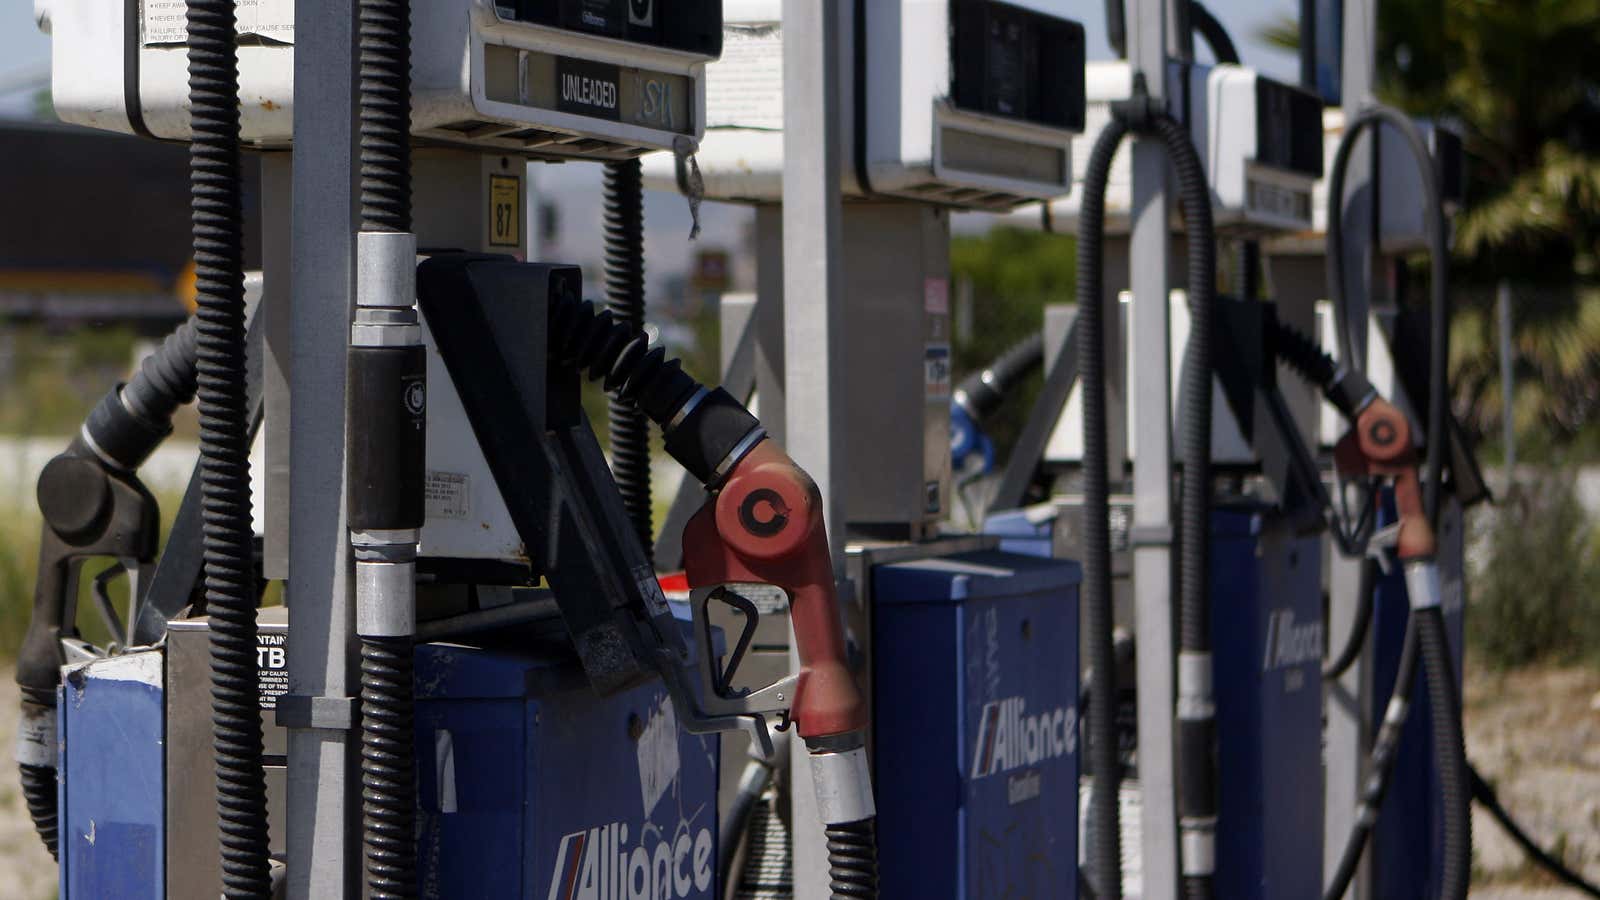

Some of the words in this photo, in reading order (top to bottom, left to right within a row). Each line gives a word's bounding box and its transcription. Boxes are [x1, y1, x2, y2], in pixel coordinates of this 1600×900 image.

[562, 72, 616, 109] UNLEADED
[496, 203, 512, 237] 87
[990, 696, 1076, 775] Alliance
[576, 822, 713, 900] Alliance
